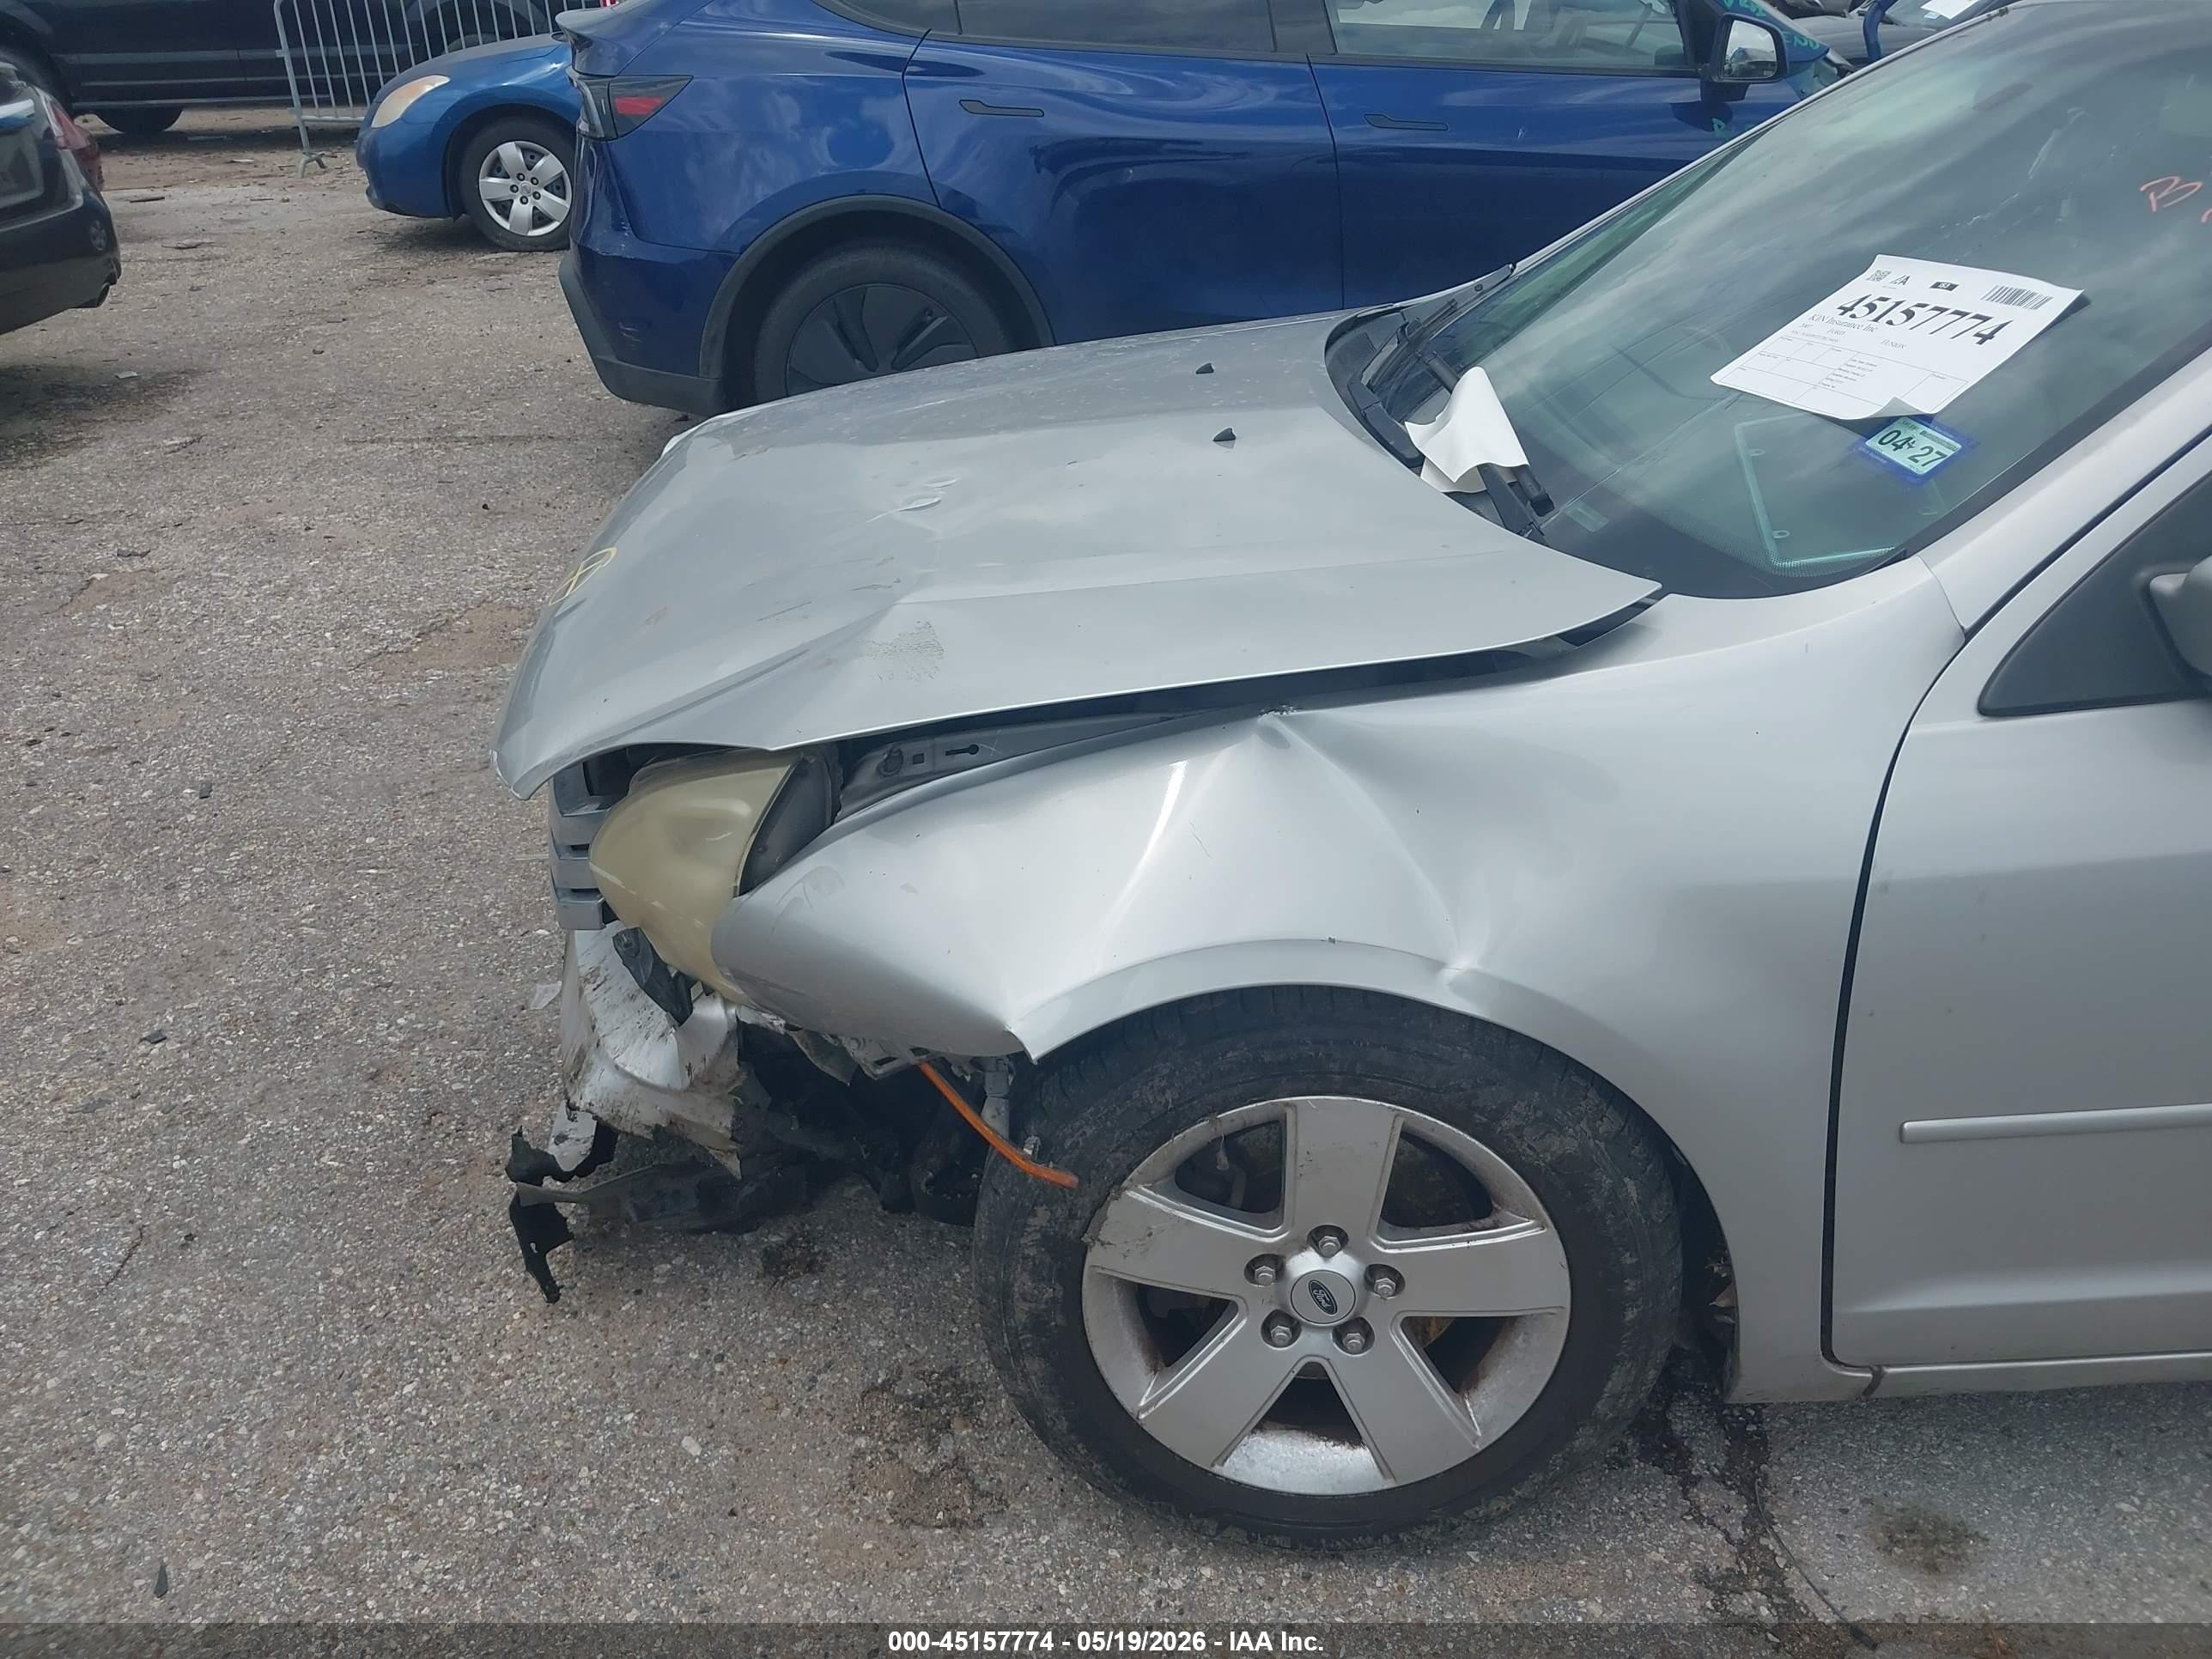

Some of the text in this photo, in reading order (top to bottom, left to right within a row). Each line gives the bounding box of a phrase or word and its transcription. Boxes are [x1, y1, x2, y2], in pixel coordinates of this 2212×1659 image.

[1808, 313, 1879, 333] KIN Insurance Inc
[1836, 294, 2014, 345] 45157774
[1878, 429, 1913, 452] 04
[1907, 445, 1948, 467] 27
